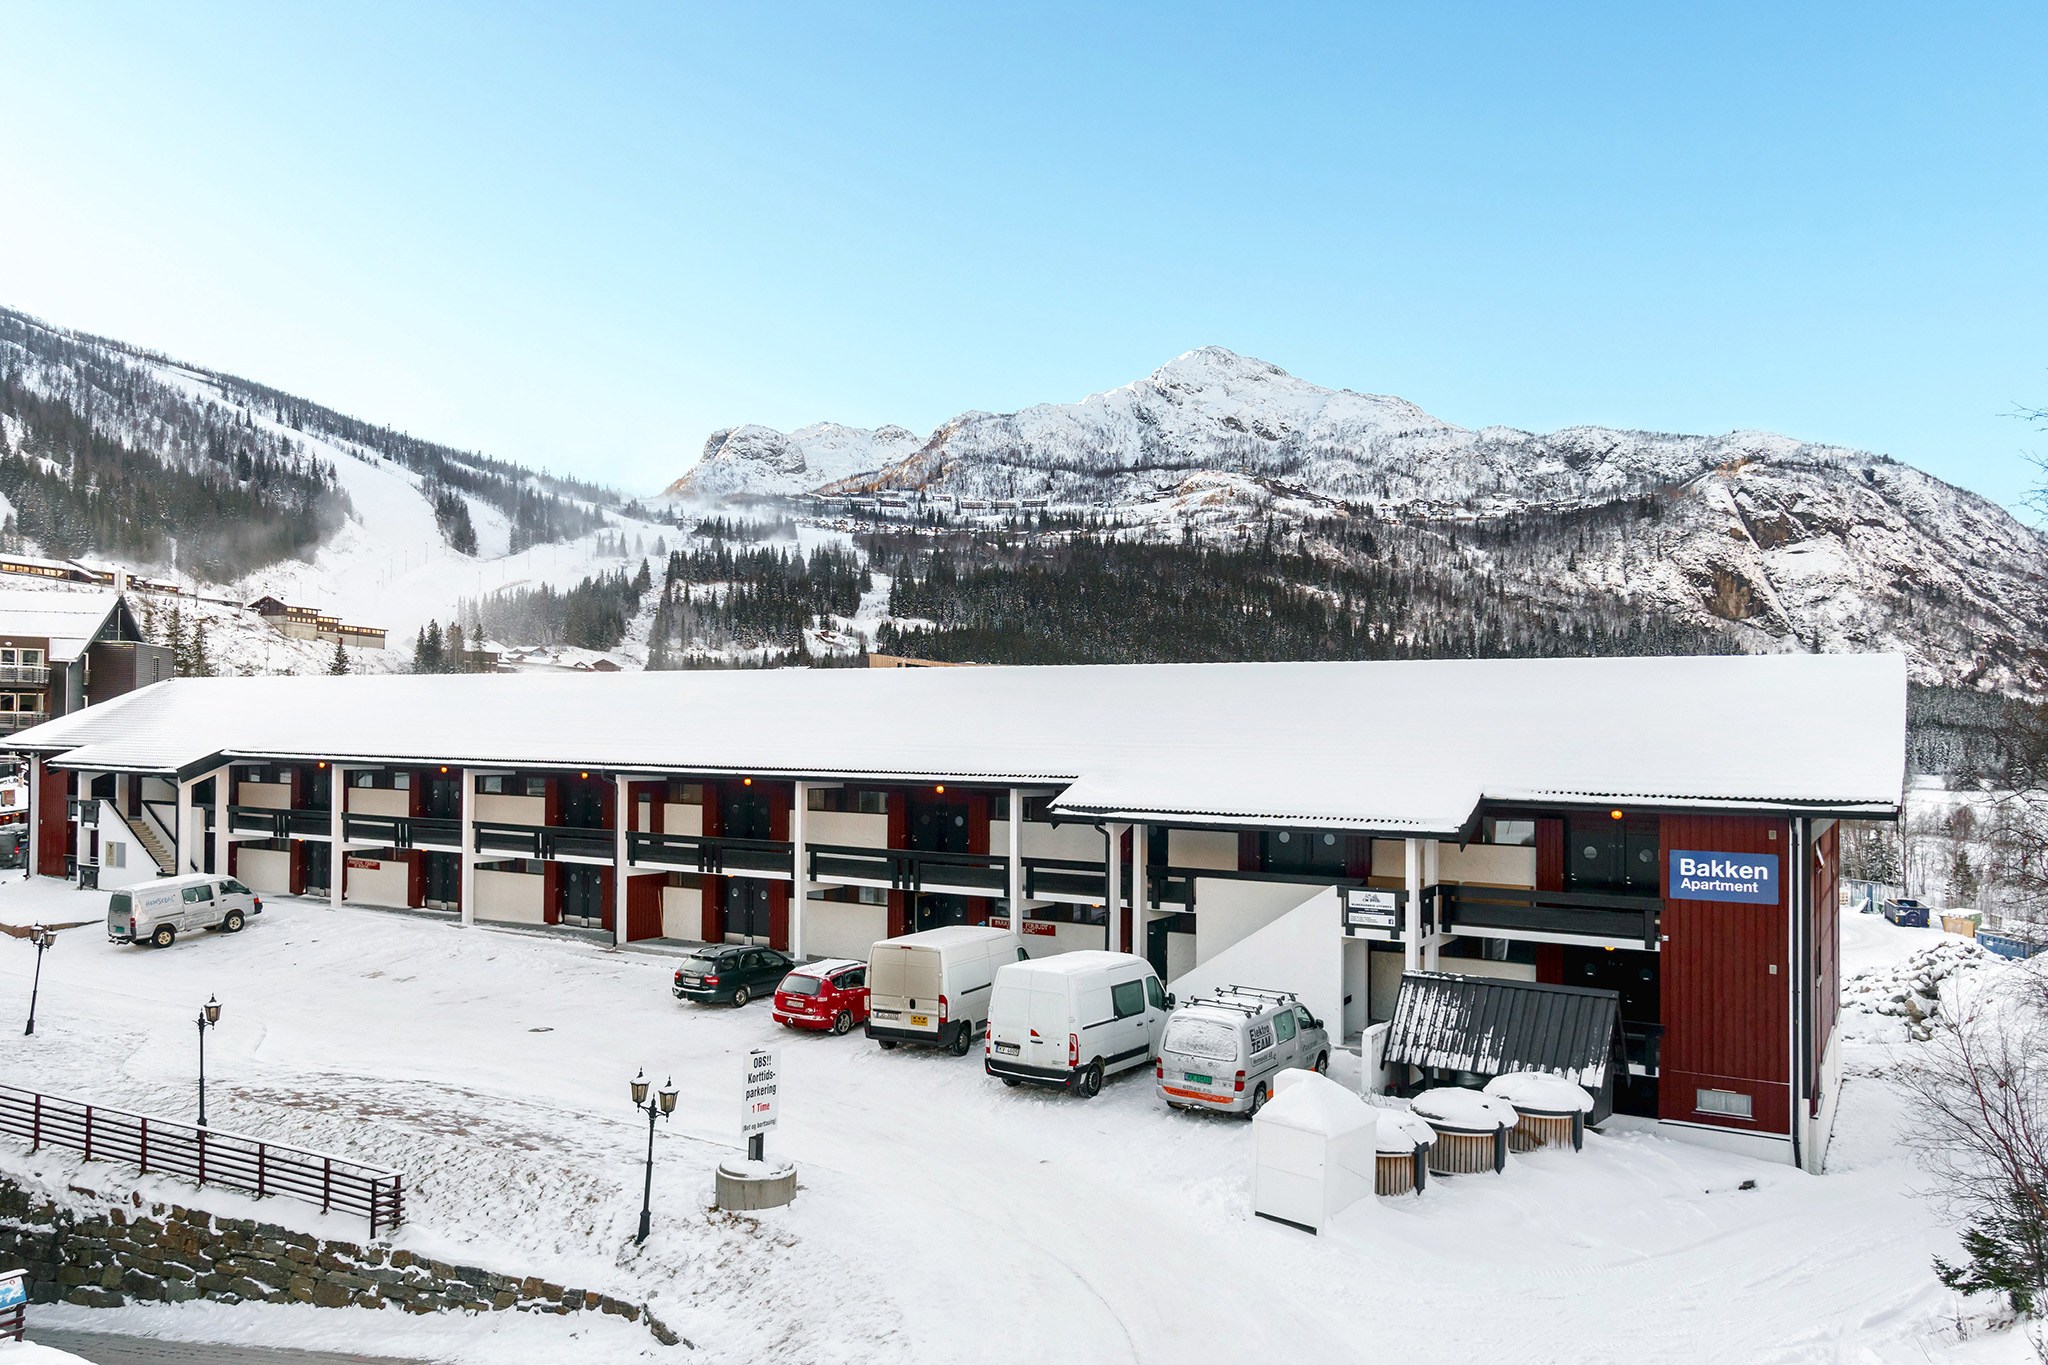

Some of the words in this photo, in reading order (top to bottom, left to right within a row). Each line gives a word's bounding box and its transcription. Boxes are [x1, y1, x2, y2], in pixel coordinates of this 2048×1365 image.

[1680, 858, 1768, 880] Bakken
[1681, 877, 1759, 893] Apartment
[1249, 1024, 1270, 1043] Elektro
[1250, 1034, 1271, 1055] TEAM
[753, 1055, 772, 1069] OBS!!
[747, 1070, 776, 1084] Korttids-
[745, 1084, 777, 1101] parkering
[751, 1104, 755, 1114] 1
[757, 1102, 770, 1112] Time
